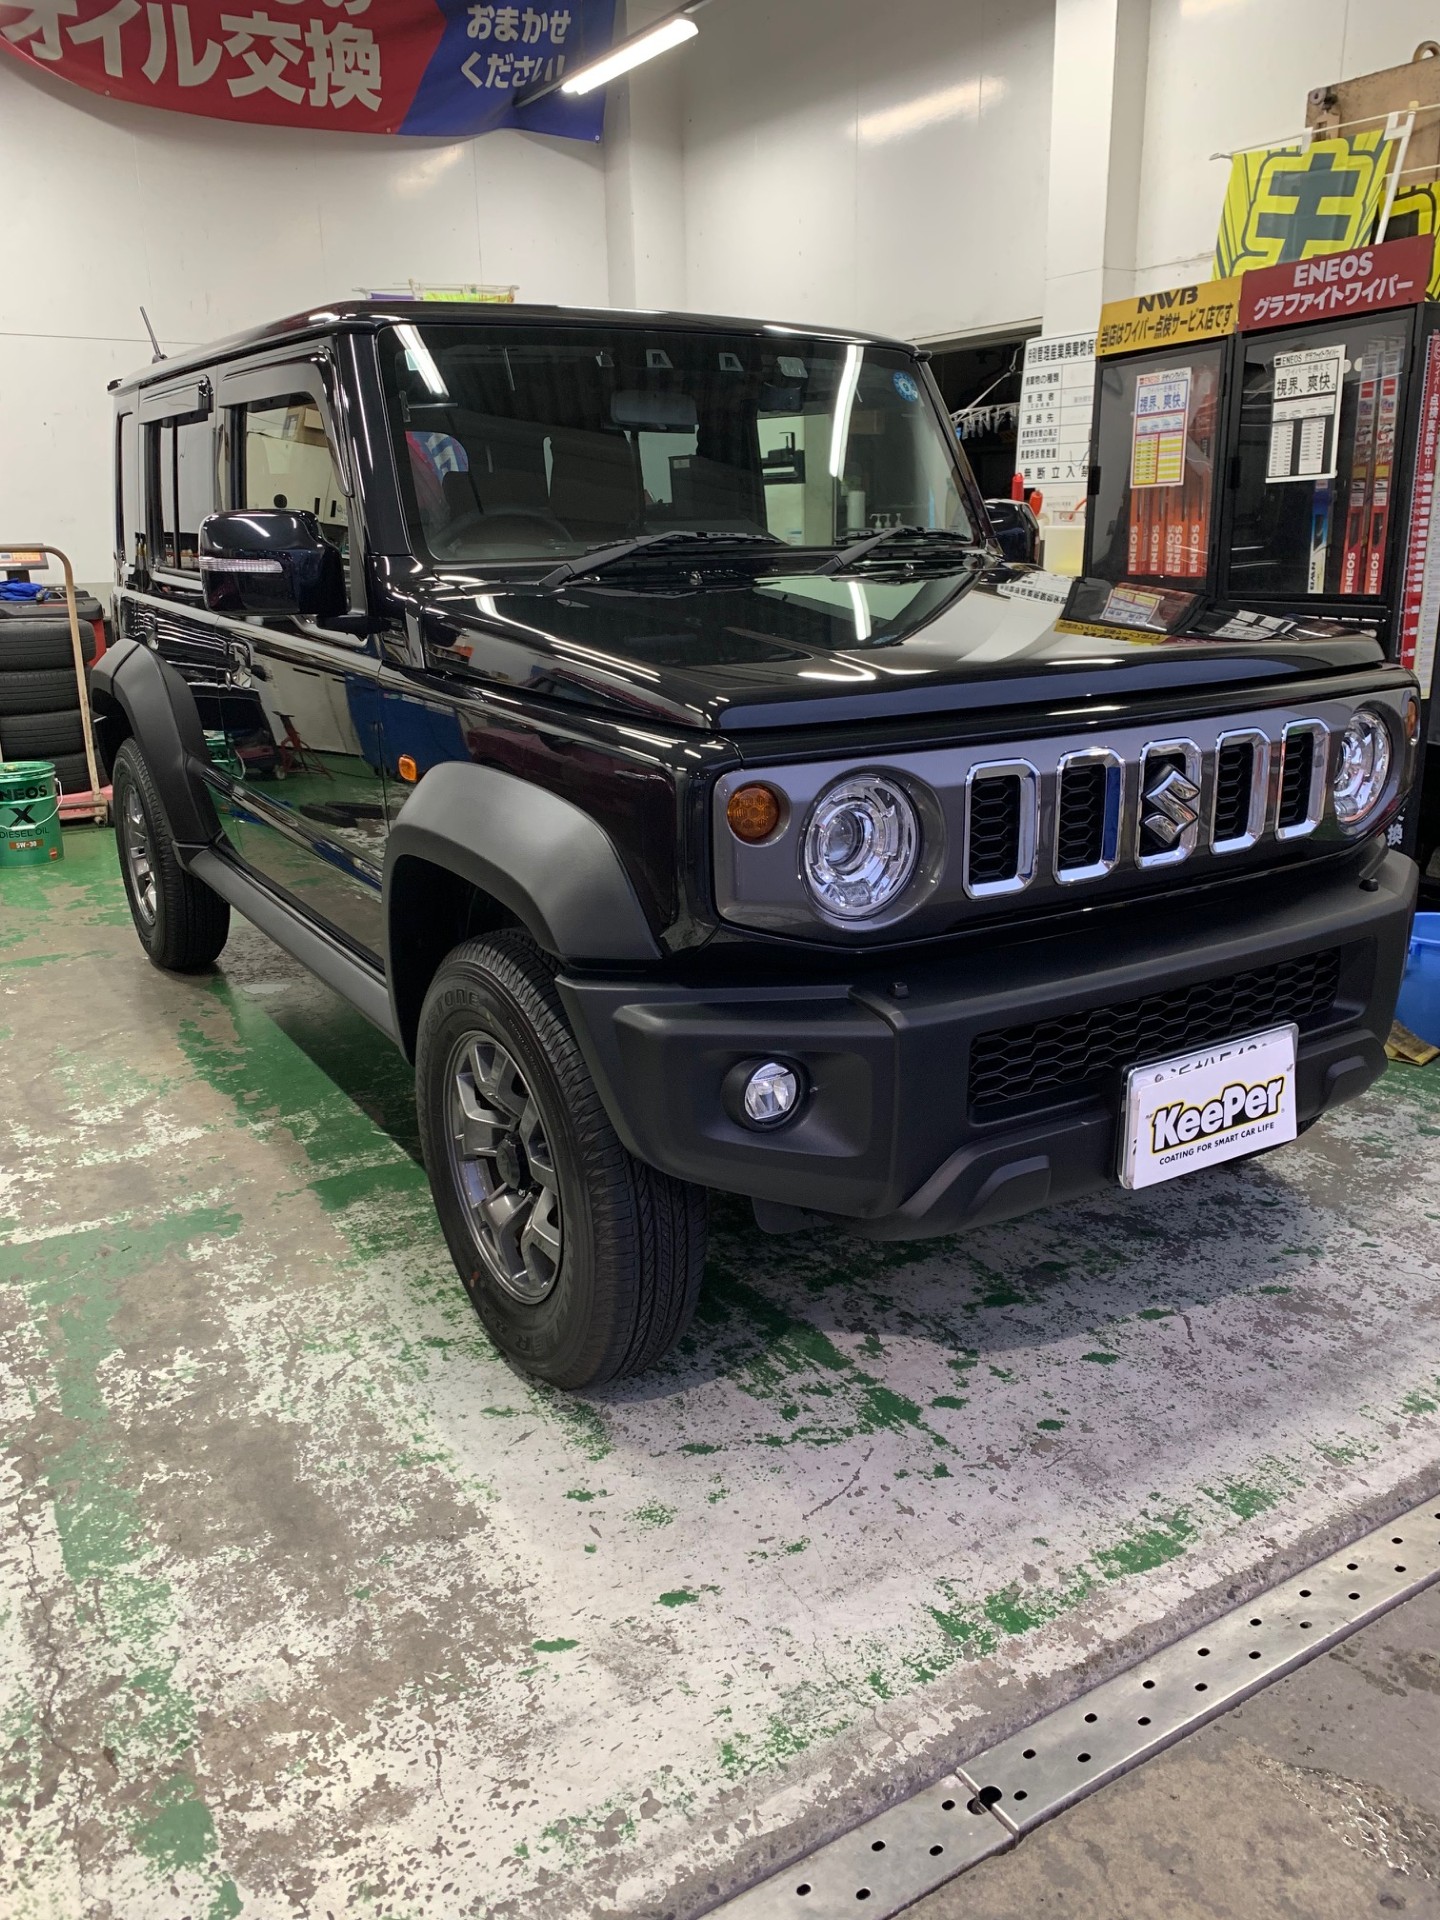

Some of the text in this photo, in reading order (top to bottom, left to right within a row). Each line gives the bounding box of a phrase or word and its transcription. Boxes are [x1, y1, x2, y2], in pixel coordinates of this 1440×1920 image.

[466, 4, 572, 44] おまかせ
[0, 0, 382, 112] オイル交換
[1293, 251, 1374, 288] ENEOS
[1137, 286, 1199, 314] NWB
[1253, 274, 1414, 322] グラファイトワイパー
[1099, 302, 1234, 348] 当店はワイパー点検サービス店です
[1027, 338, 1096, 364] 特別管理産業廃棄物保
[1281, 353, 1302, 366] ENEOS
[1140, 392, 1186, 413] 視界、爽快。
[1276, 371, 1336, 397] 視界、爽快。
[1128, 525, 1138, 571] ENEOS
[1150, 525, 1160, 571] ENEOS
[1173, 525, 1183, 573] ENEOS
[1189, 524, 1200, 573] ENEOS
[1344, 552, 1356, 594] ENEOS
[1368, 552, 1380, 594] ENEOS
[0, 827, 50, 839] DIESEL OIL
[8, 804, 37, 827] X
[15, 840, 37, 849] 5W-30
[1152, 1076, 1285, 1154] KeePer
[1159, 1122, 1275, 1165] COATING FOR SMART CAR LIFE
